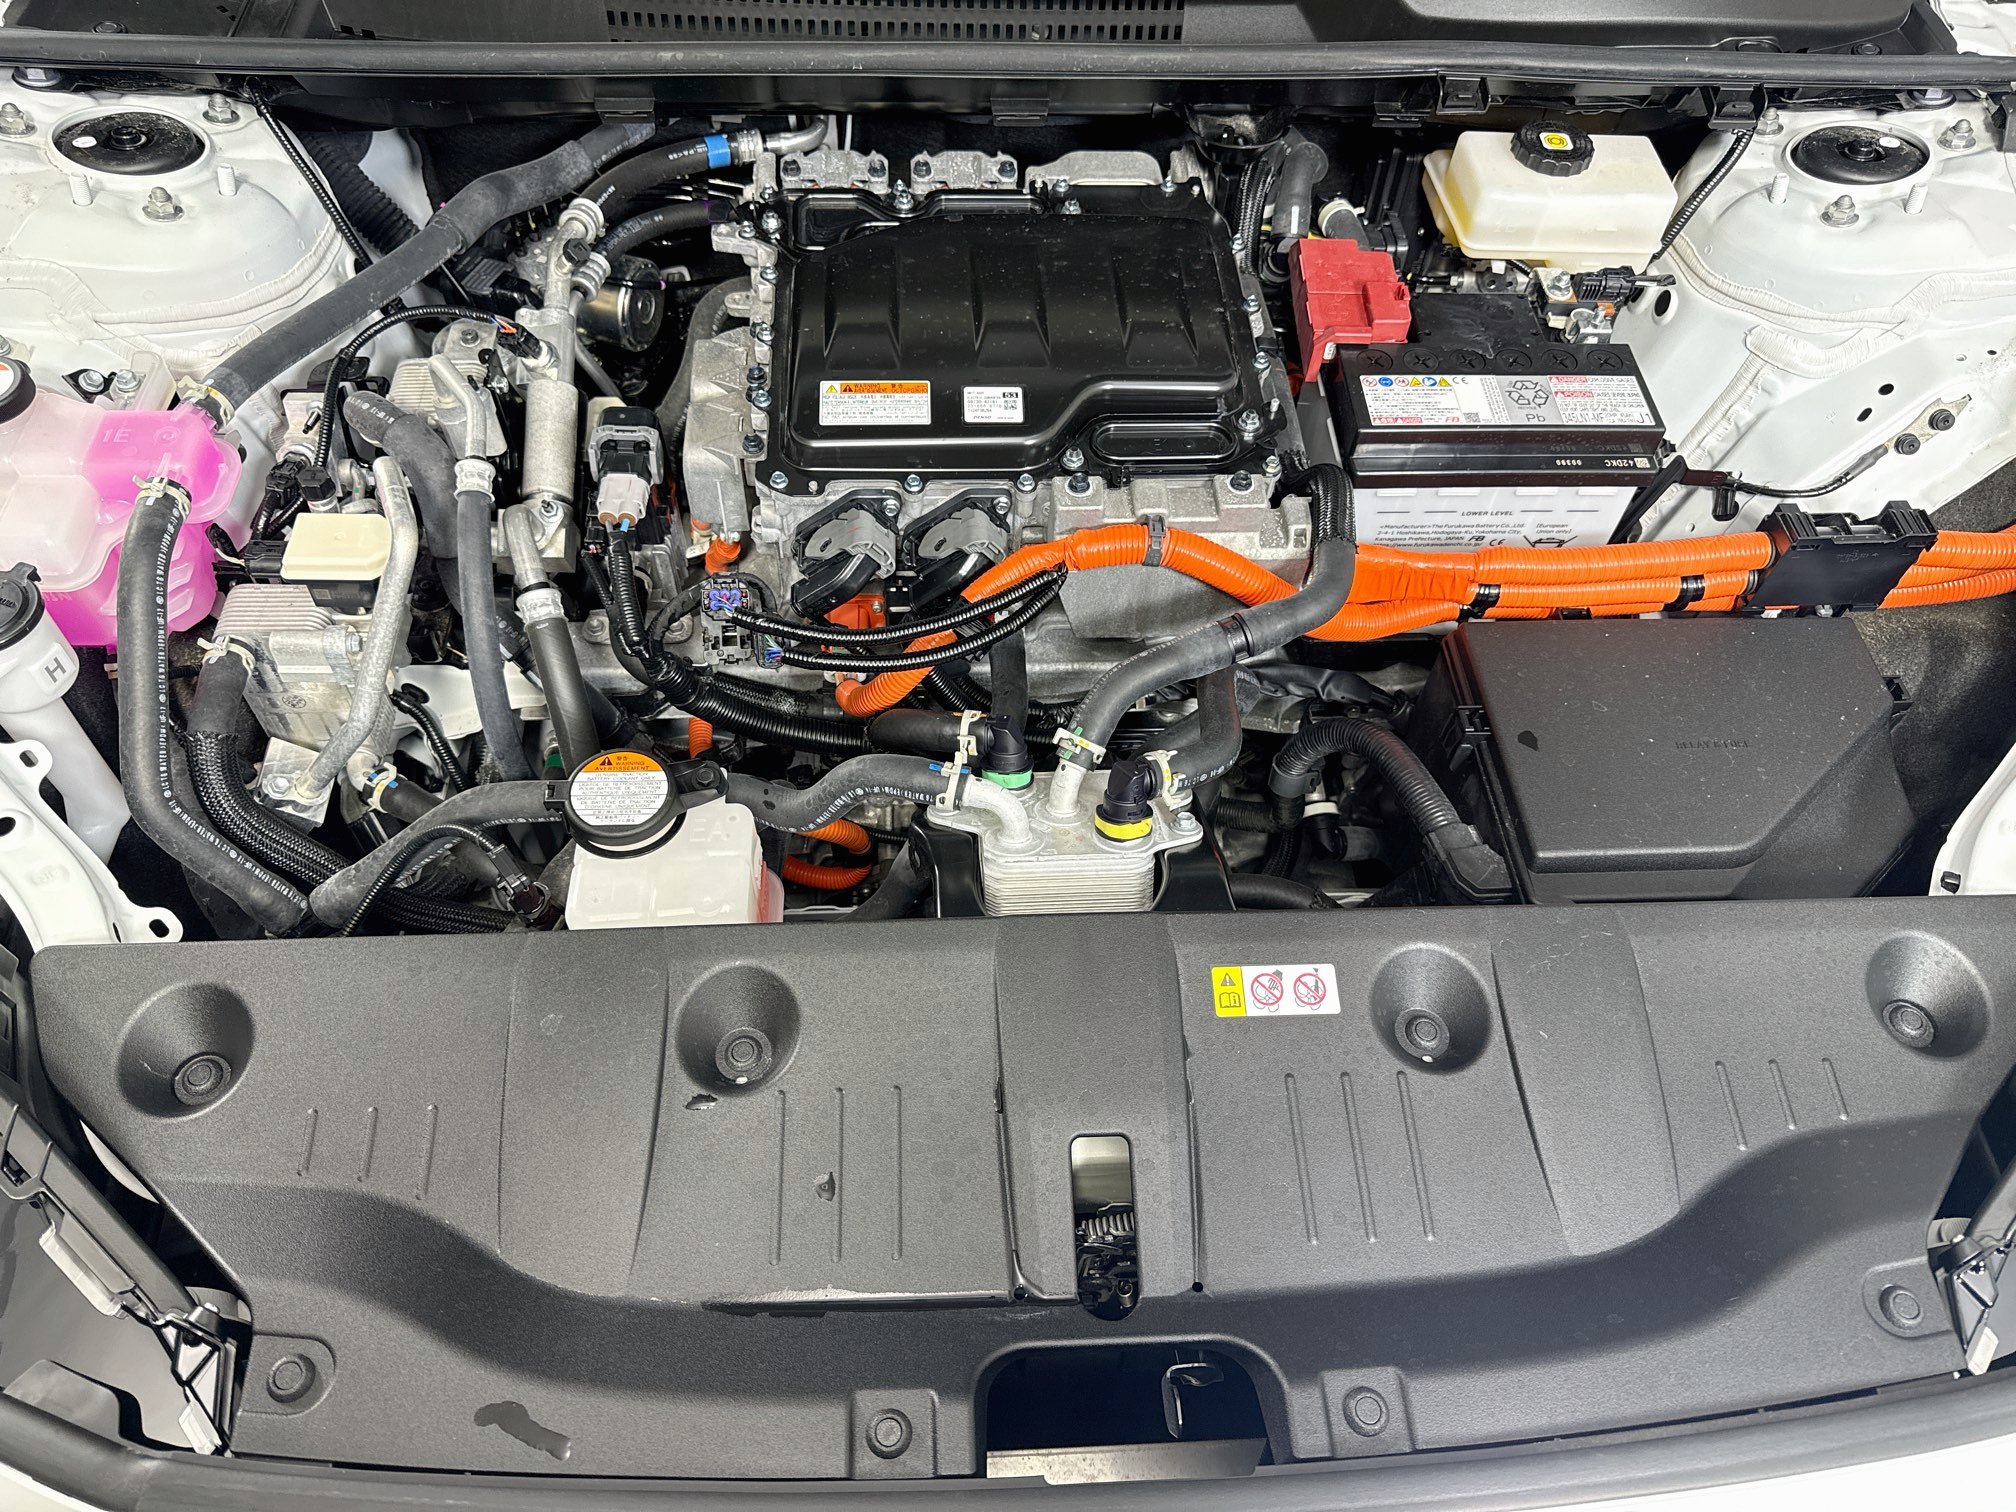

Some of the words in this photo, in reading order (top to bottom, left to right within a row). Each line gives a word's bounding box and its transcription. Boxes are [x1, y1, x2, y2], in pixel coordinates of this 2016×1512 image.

[1526, 414, 1546, 422] Pb
[156, 554, 166, 576] WATER
[44, 657, 67, 683] H
[157, 652, 166, 673] WATER
[159, 750, 167, 771] WATER
